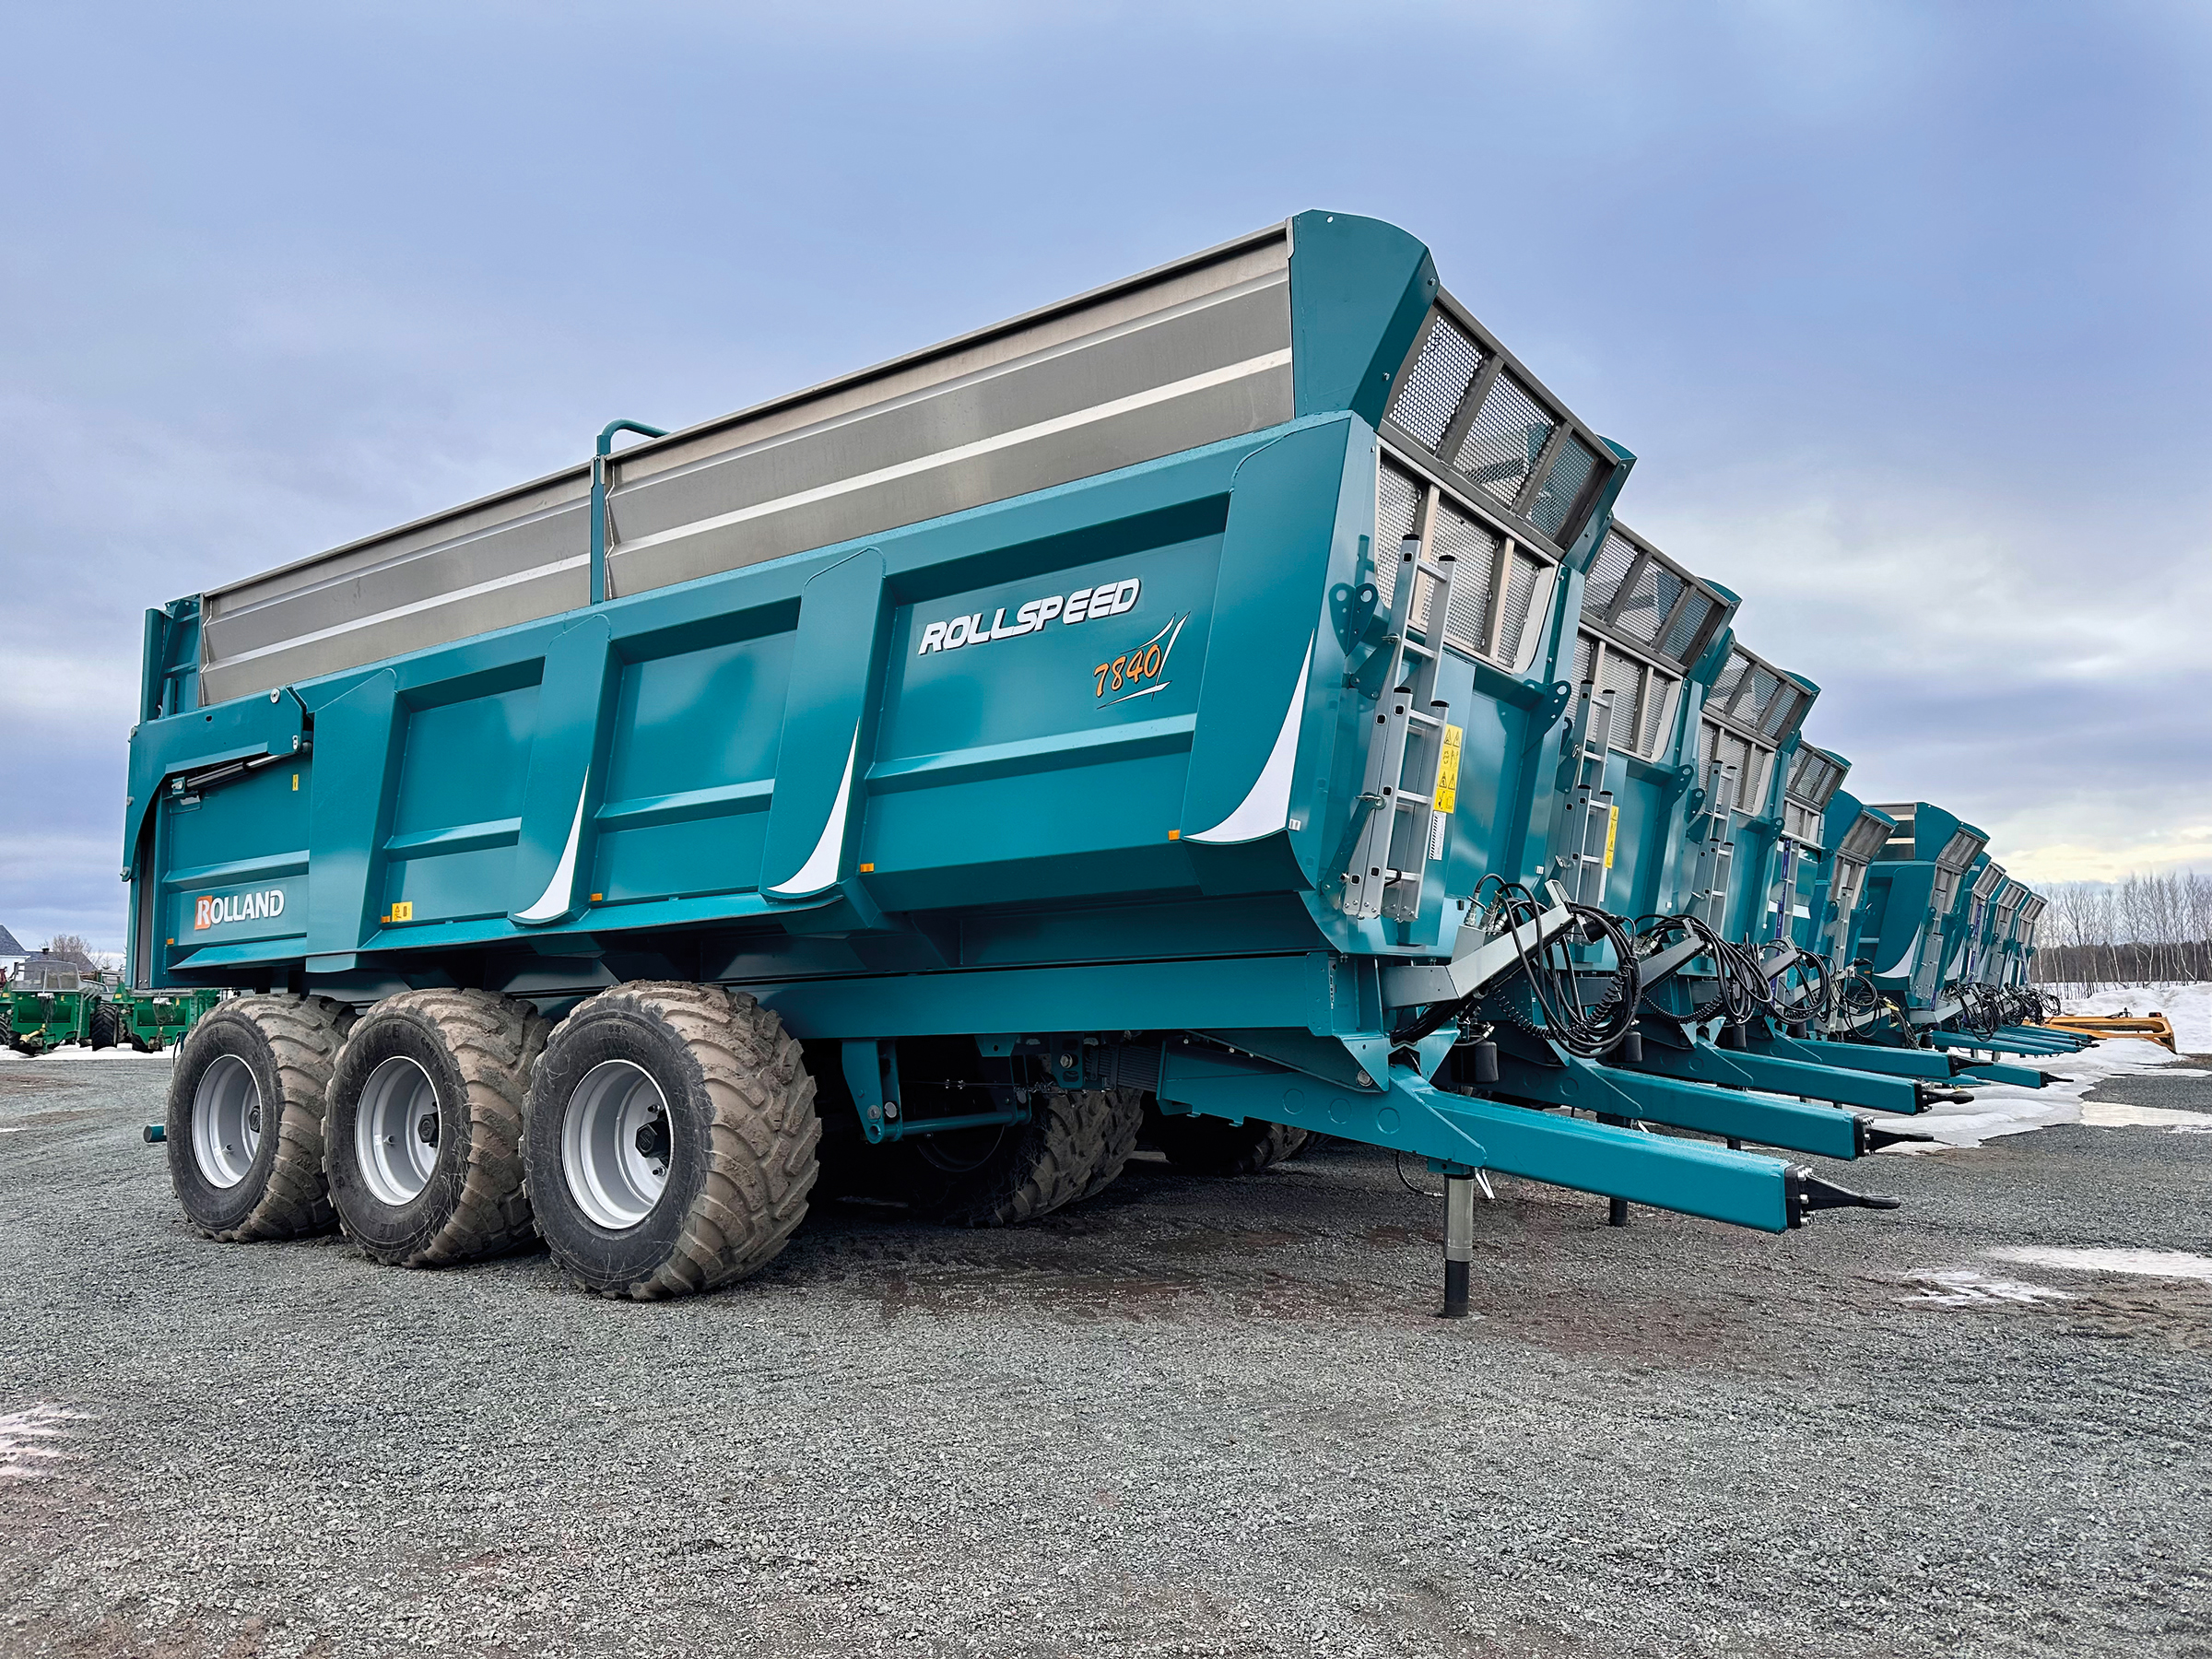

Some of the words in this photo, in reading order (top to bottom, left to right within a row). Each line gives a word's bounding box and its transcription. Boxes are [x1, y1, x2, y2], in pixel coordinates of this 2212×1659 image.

[918, 578, 1141, 655] ROLLSPEED
[1093, 644, 1160, 697] 7840
[195, 889, 285, 929] ROLLAND
